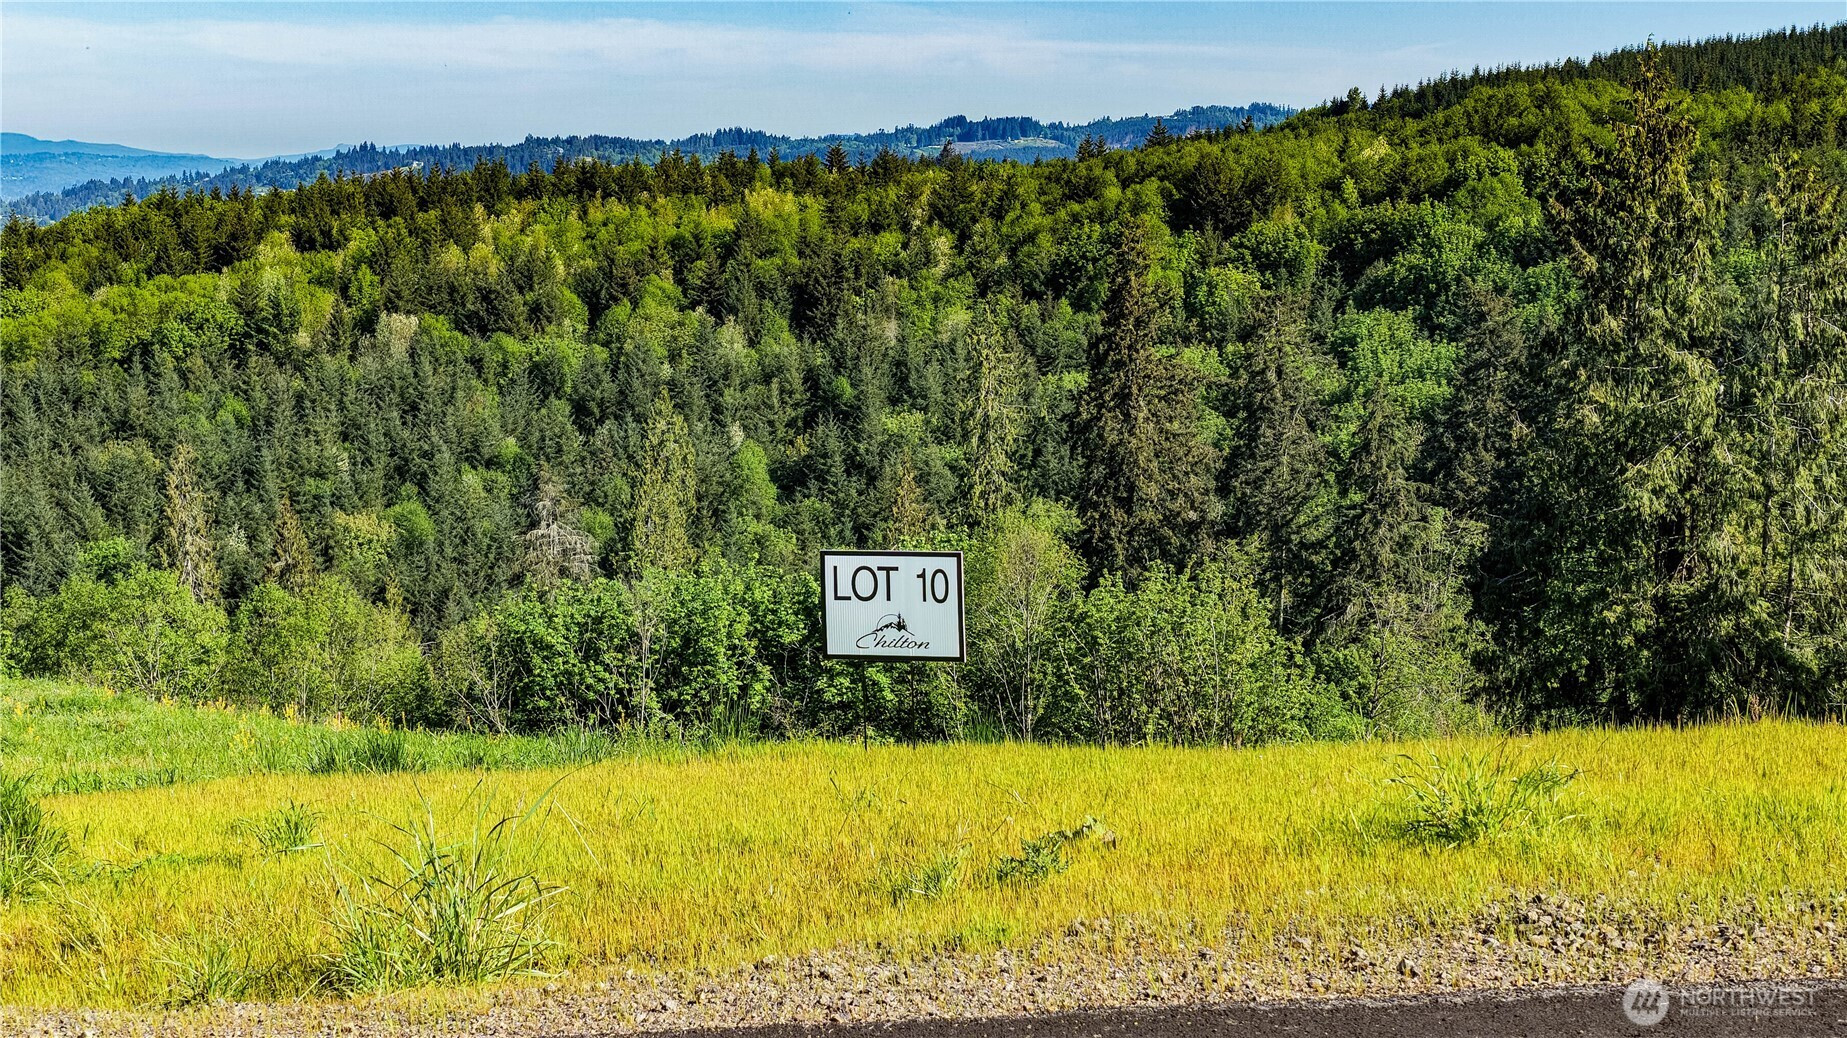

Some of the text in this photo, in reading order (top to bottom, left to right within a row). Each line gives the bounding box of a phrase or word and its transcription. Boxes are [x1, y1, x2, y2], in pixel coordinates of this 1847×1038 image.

[833, 565, 949, 603] LOT 10
[855, 632, 930, 649] Chilton
